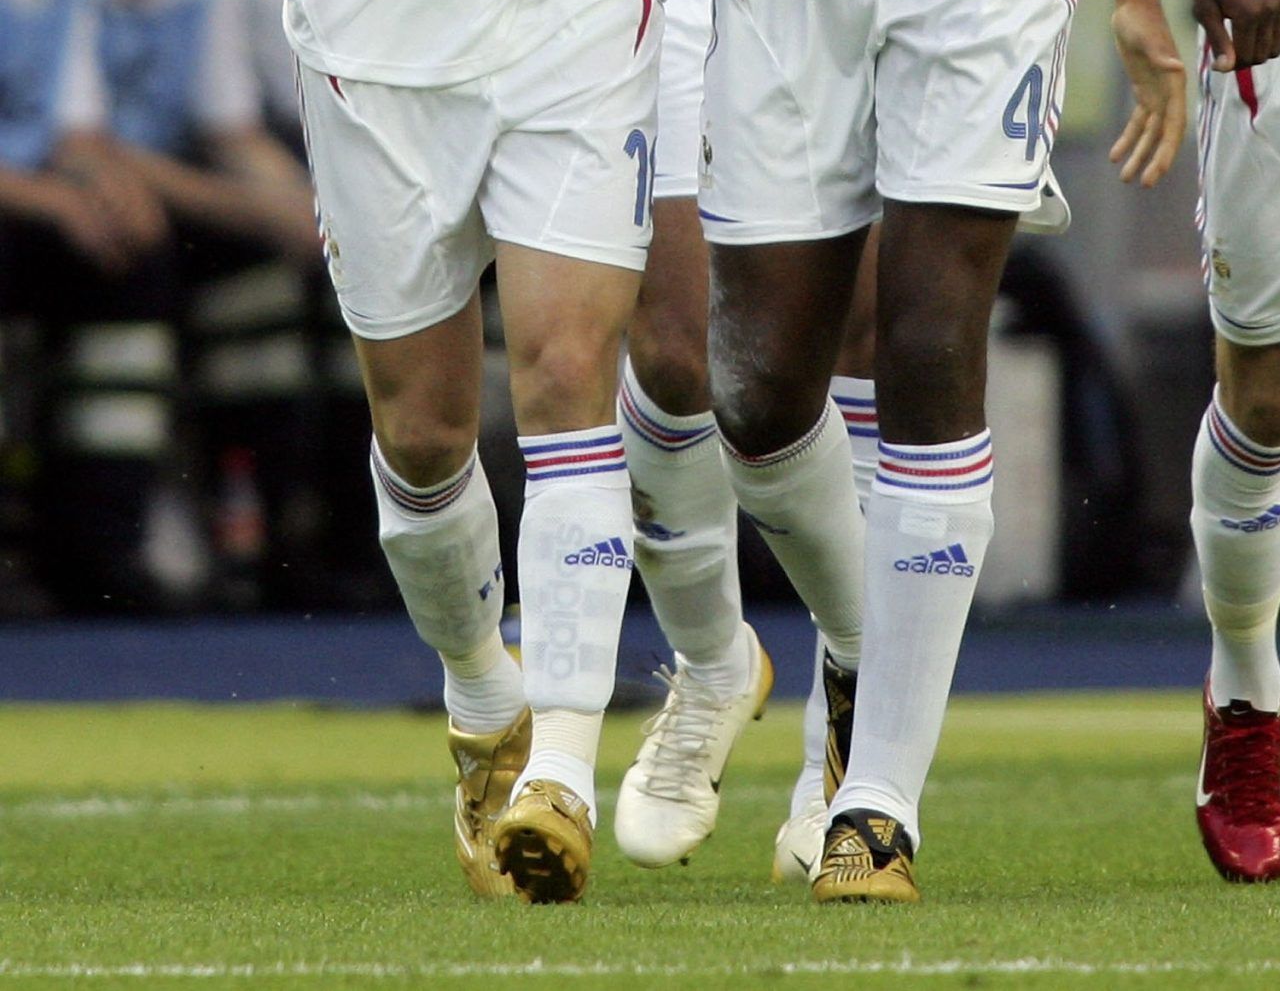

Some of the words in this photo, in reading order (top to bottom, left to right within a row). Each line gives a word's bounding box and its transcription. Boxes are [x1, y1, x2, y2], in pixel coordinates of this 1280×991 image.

[1001, 64, 1044, 162] 4
[623, 128, 657, 227] 1
[564, 547, 635, 571] adidas
[894, 556, 975, 578] adidas
